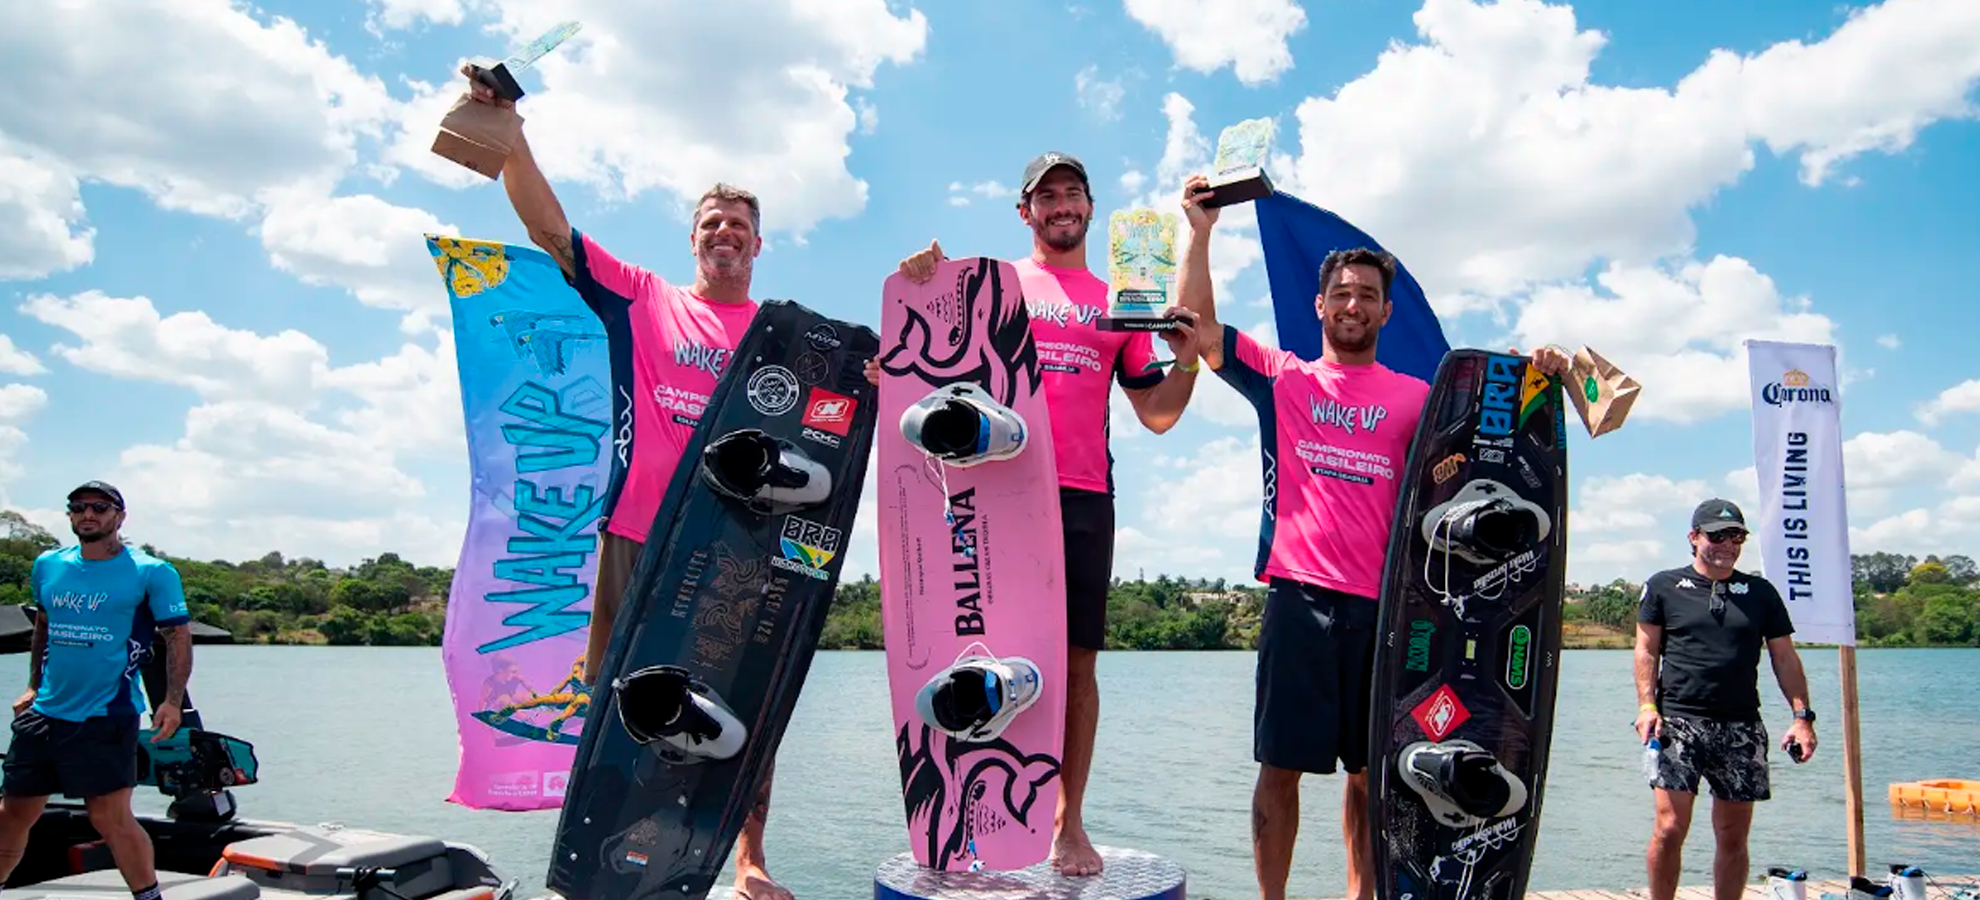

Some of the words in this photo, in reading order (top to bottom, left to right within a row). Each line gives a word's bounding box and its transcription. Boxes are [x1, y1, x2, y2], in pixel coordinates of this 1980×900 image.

[1075, 303, 1102, 325] UP
[673, 331, 726, 380] WAKE
[1035, 341, 1100, 358] PEONATO
[1036, 350, 1102, 373] SILEIRO
[655, 384, 711, 404] CAMPE
[1480, 355, 1520, 436] BRA
[1762, 381, 1832, 408] Corona
[498, 380, 612, 474] UP
[1309, 393, 1357, 435] WAKE
[1361, 404, 1388, 433] UP
[1295, 446, 1395, 481] BRASILEIRO
[1298, 439, 1391, 466] CAMPEONATO
[1783, 431, 1809, 511] LIVING
[1784, 517, 1809, 540] IS
[476, 476, 604, 655] WAKE
[950, 486, 986, 637] BALLENA
[1788, 547, 1813, 601] THIS
[52, 590, 85, 614] WAKE
[88, 590, 108, 612] UP
[49, 622, 109, 633] AMPEONATO
[49, 629, 114, 642] RASILEIRO
